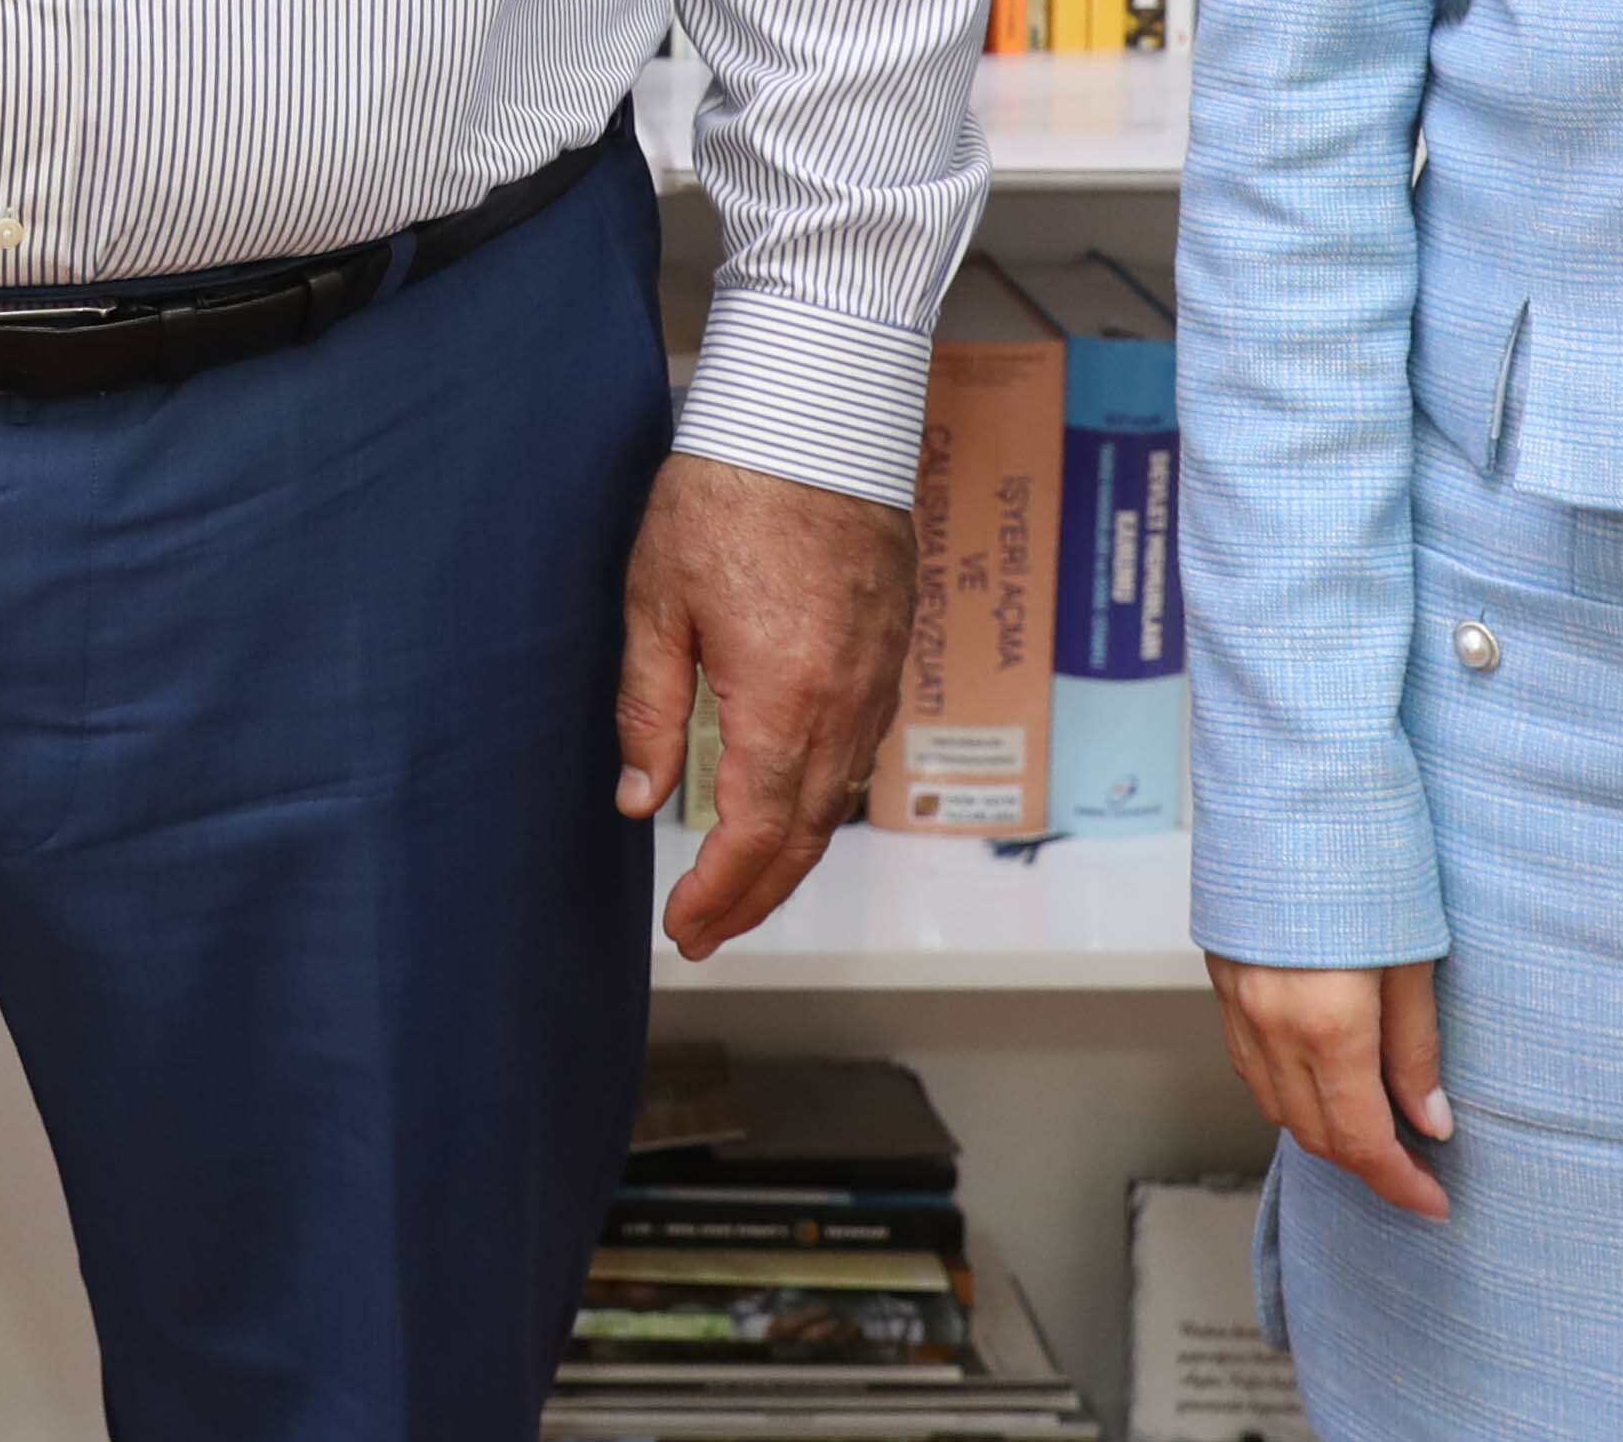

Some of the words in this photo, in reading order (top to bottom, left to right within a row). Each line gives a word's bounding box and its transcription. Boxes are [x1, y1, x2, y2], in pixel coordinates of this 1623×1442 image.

[916, 424, 952, 558] ÇALIŞMA
[995, 474, 1033, 577] İŞYERİ
[957, 551, 989, 594] VE
[915, 566, 947, 717] MEVZUATI
[992, 583, 1026, 668] AÇMA
